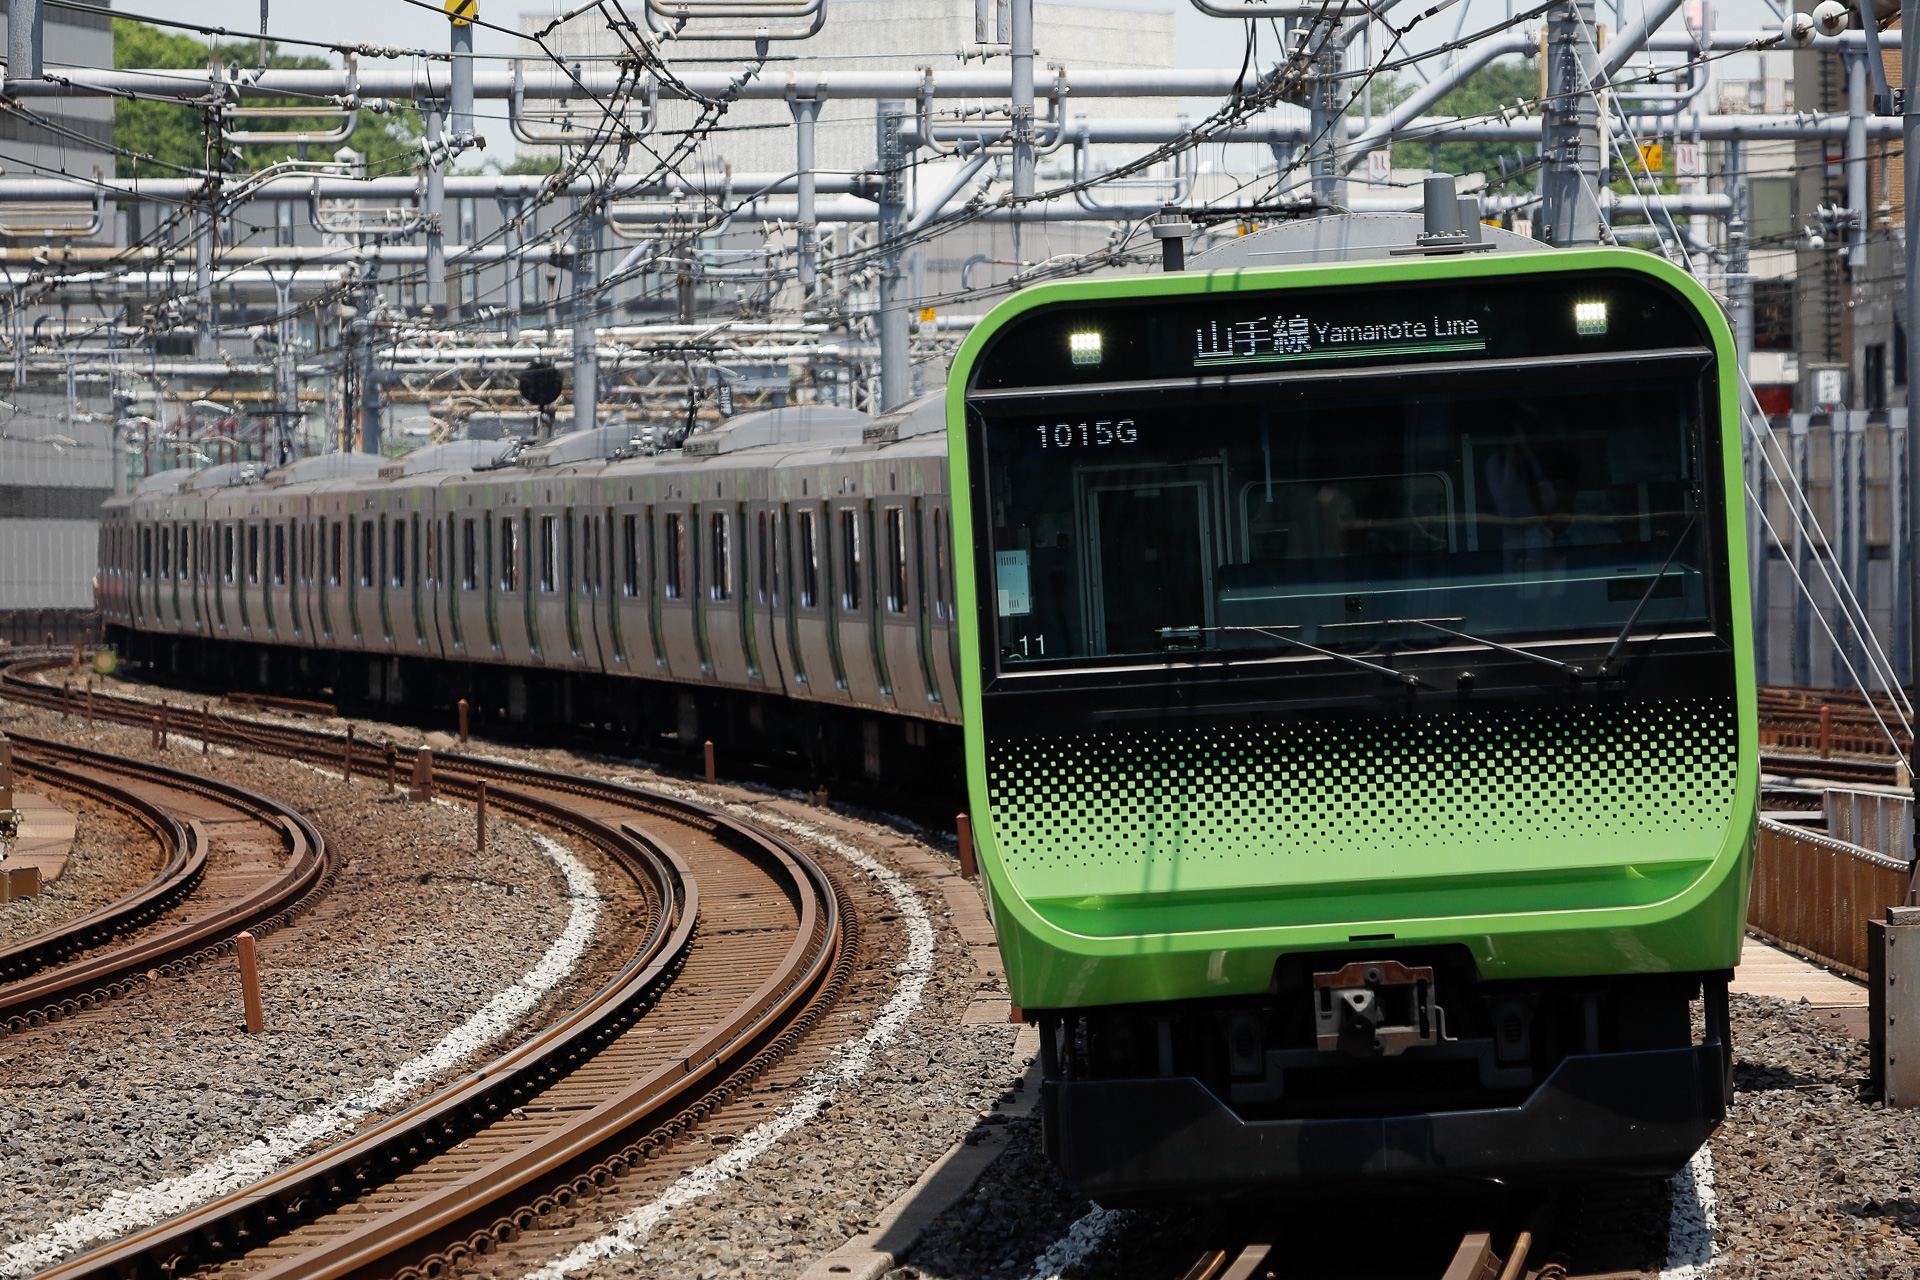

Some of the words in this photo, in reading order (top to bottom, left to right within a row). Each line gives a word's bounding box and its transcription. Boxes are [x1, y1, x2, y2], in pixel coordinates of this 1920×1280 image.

[1196, 315, 1311, 357] 山手線
[1314, 320, 1427, 343] Yamanote
[1434, 316, 1479, 336] Line
[1037, 419, 1137, 448] 1015G
[1019, 634, 1045, 655] 11
